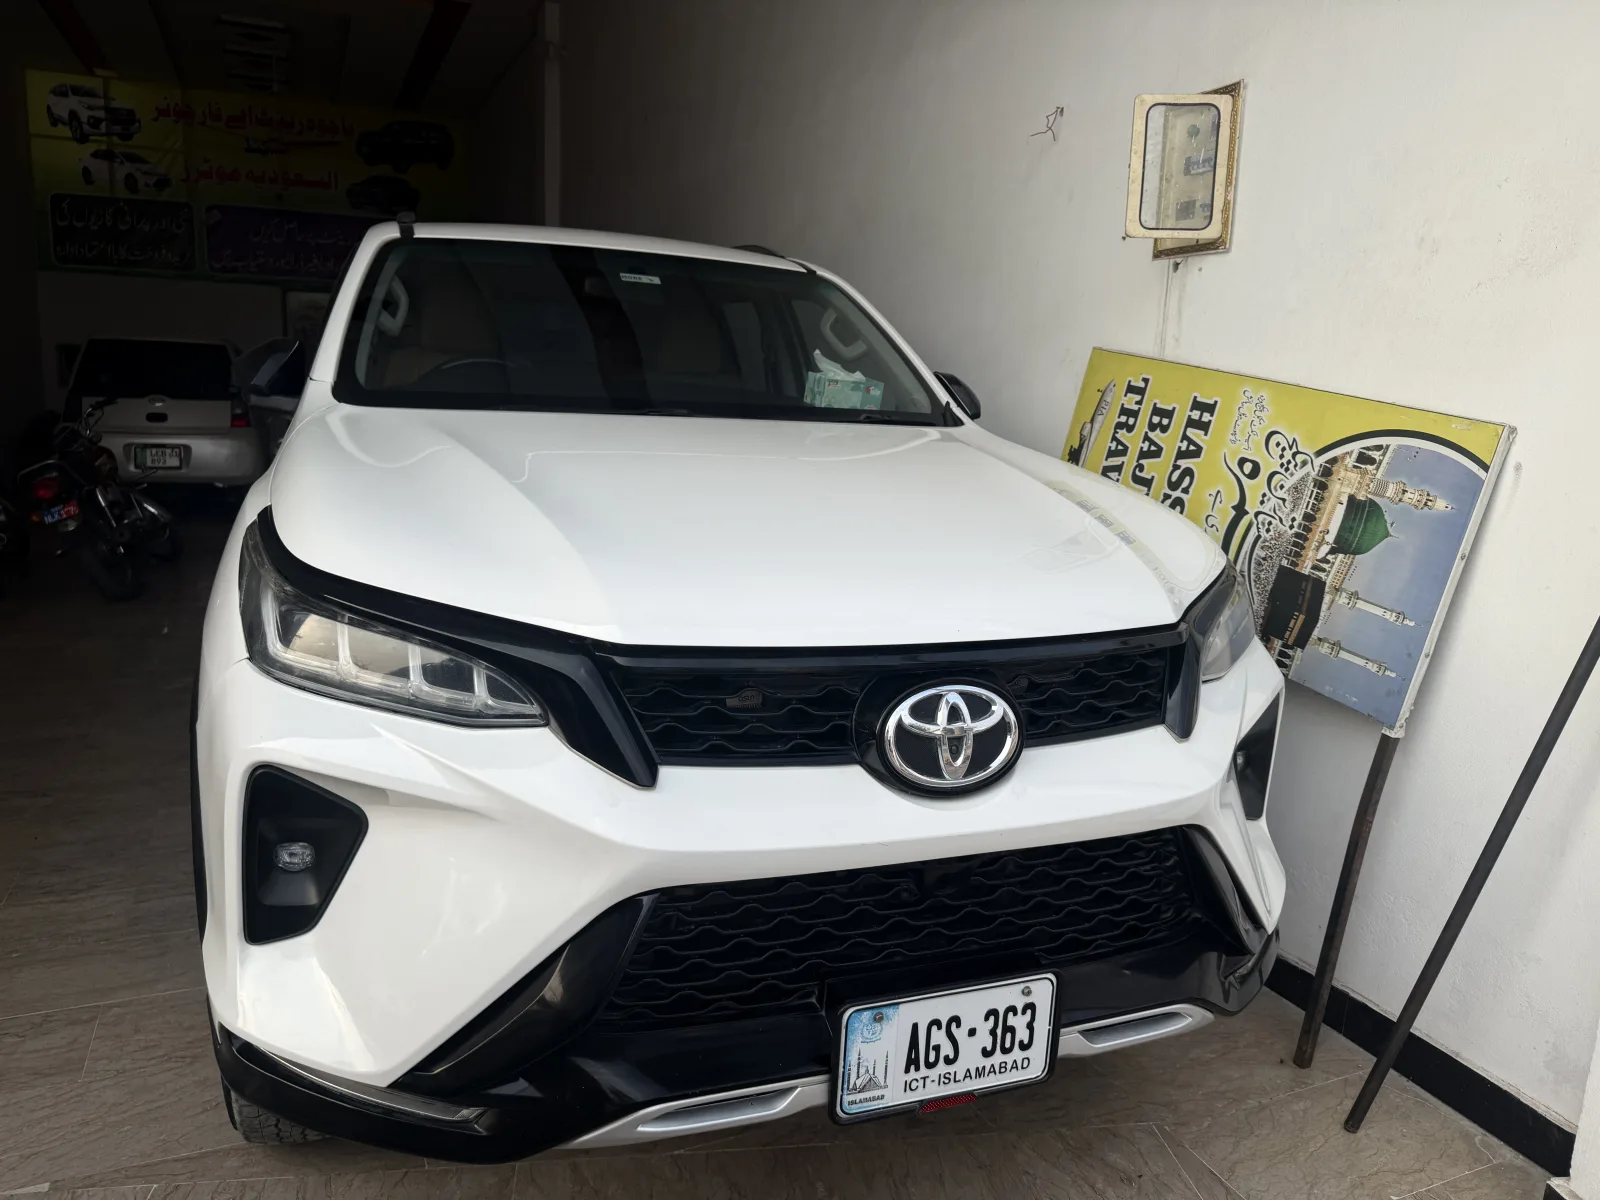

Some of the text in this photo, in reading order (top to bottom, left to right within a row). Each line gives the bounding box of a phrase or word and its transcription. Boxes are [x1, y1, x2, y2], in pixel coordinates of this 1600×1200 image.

[1097, 399, 1110, 417] PIA
[1130, 401, 1177, 498] BAJ
[1265, 430, 1317, 474] پیکج
[1208, 489, 1223, 513] ہے
[1220, 452, 1263, 556] مرہ
[1259, 470, 1298, 531] ترین
[903, 1001, 1038, 1075] AGS-363
[903, 1055, 1032, 1093] ICT-ISLAMABAD
[846, 1093, 886, 1107] ISLAMABAD
